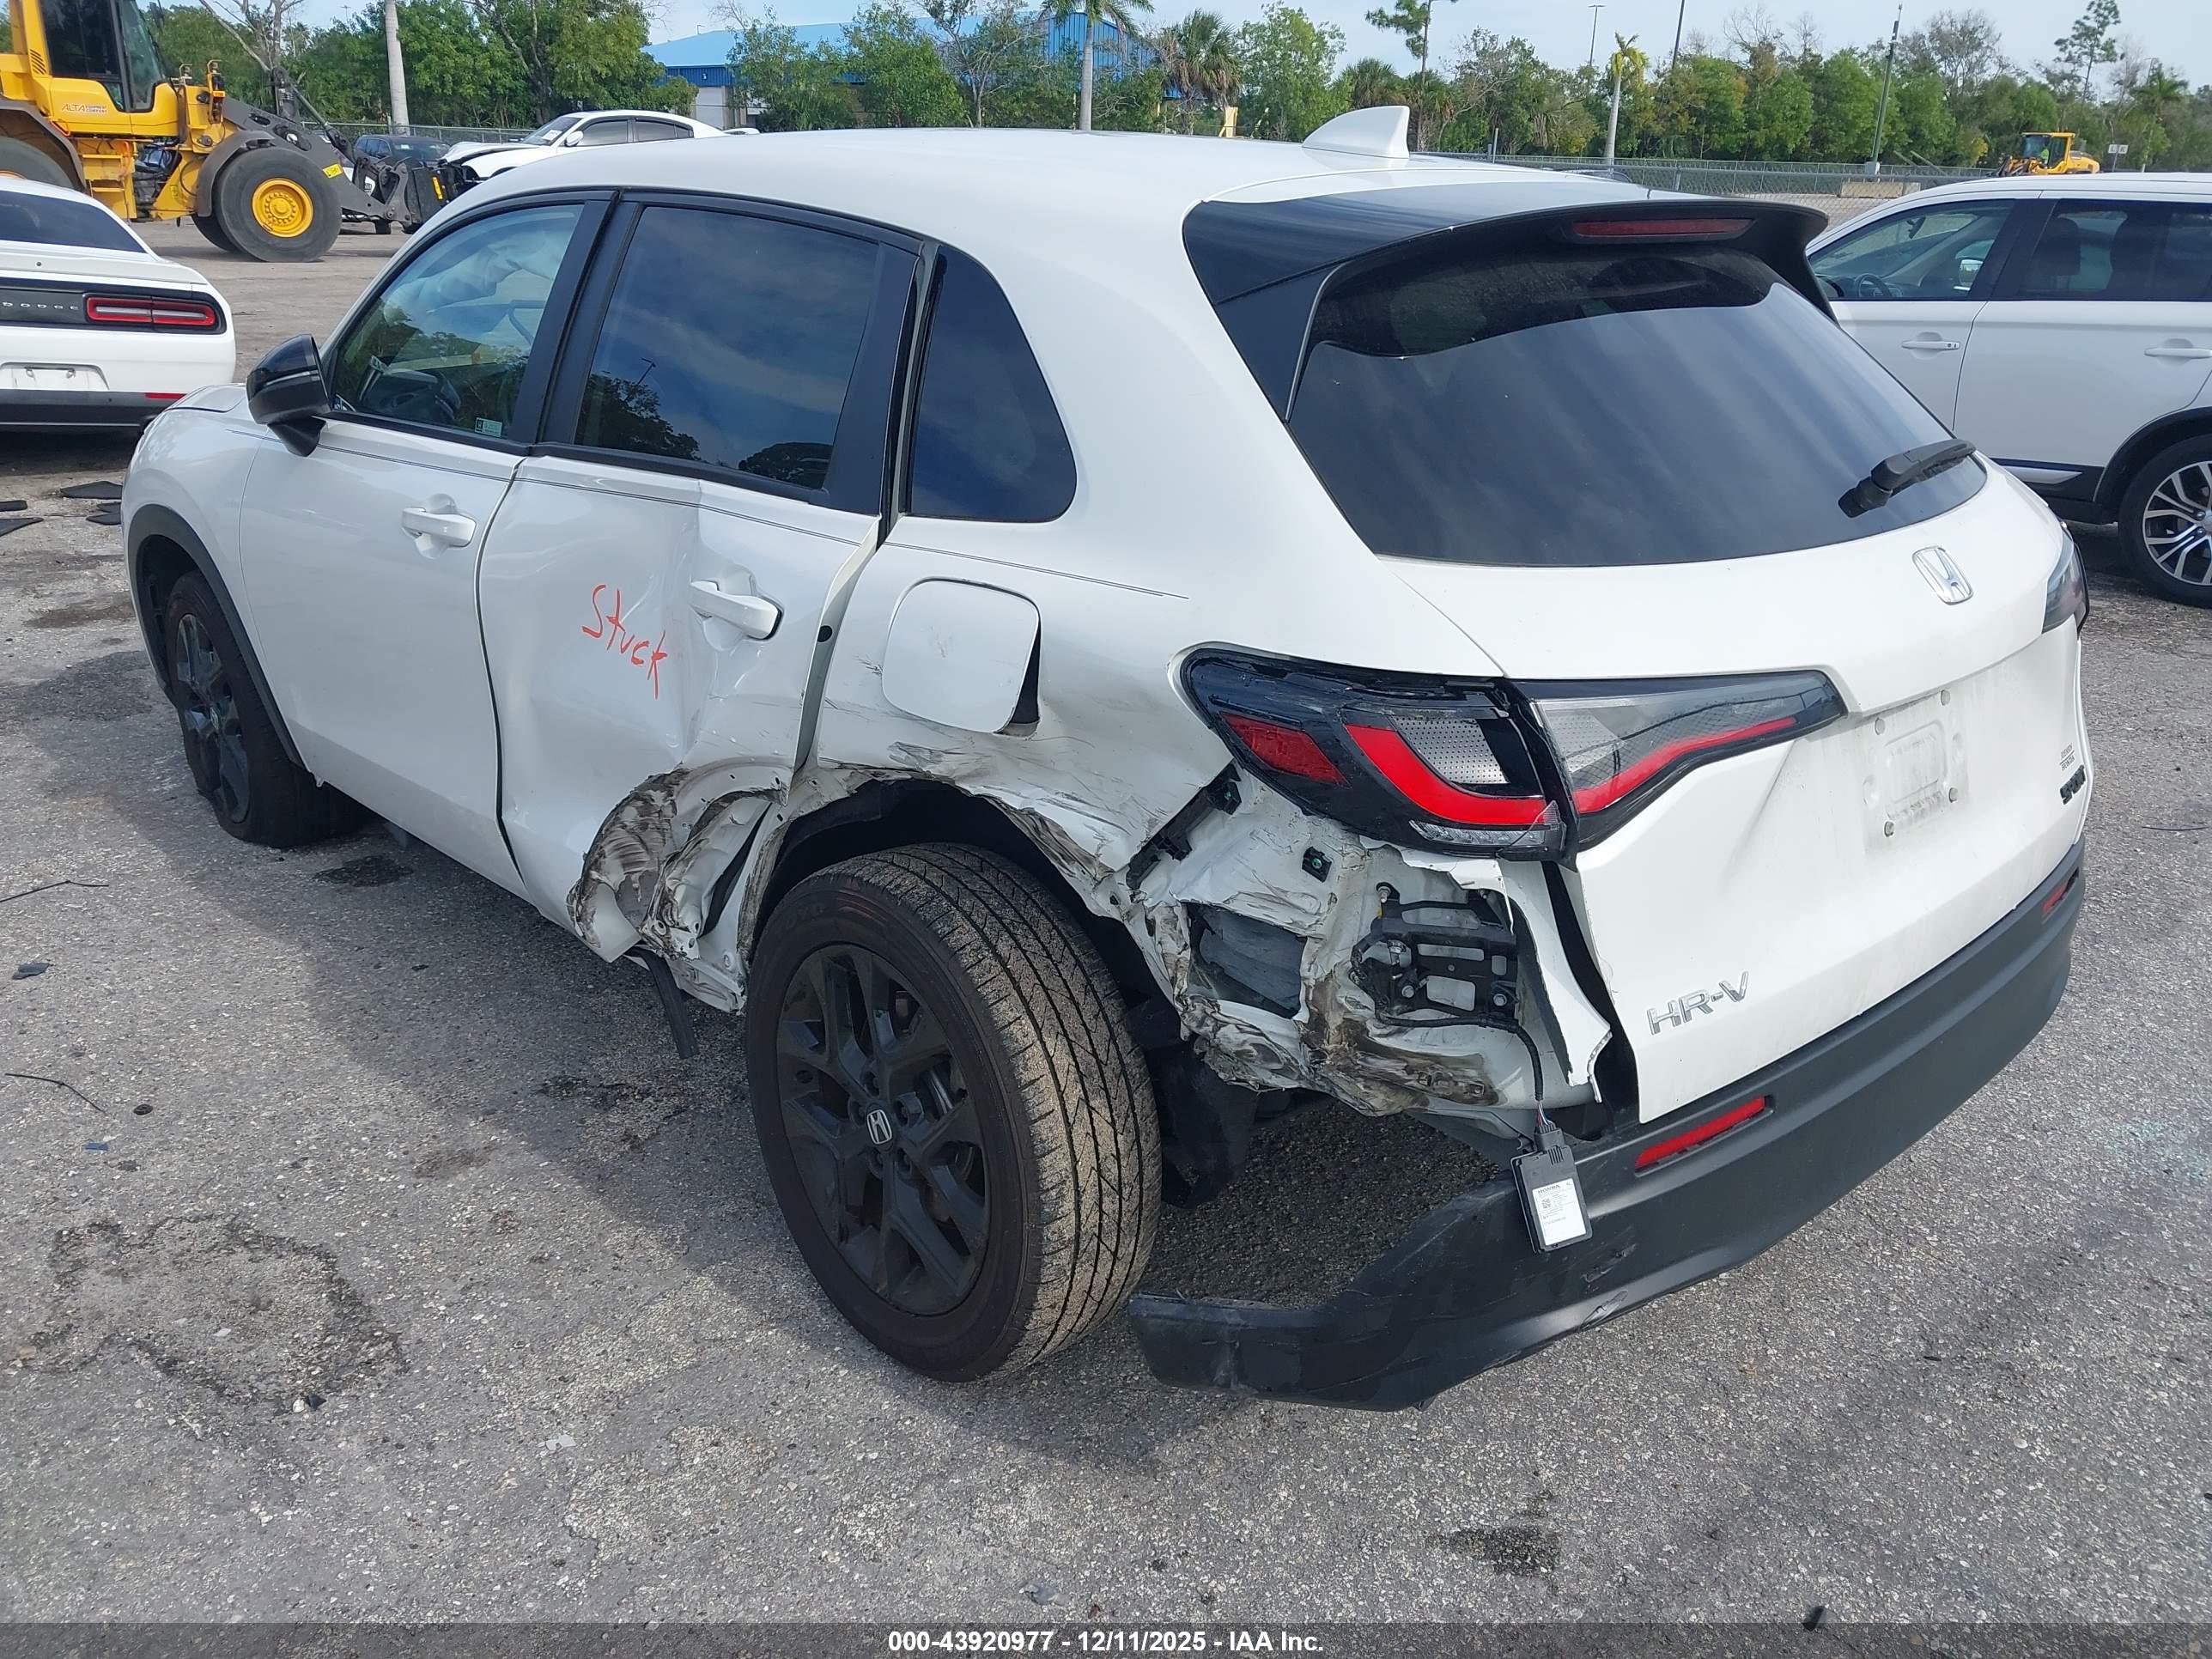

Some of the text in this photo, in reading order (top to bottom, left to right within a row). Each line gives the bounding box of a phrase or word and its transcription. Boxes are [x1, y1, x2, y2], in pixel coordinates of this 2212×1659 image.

[61, 103, 86, 112] ALTA
[2, 301, 79, 310] DODGE
[1646, 971, 1749, 1036] HR-V
